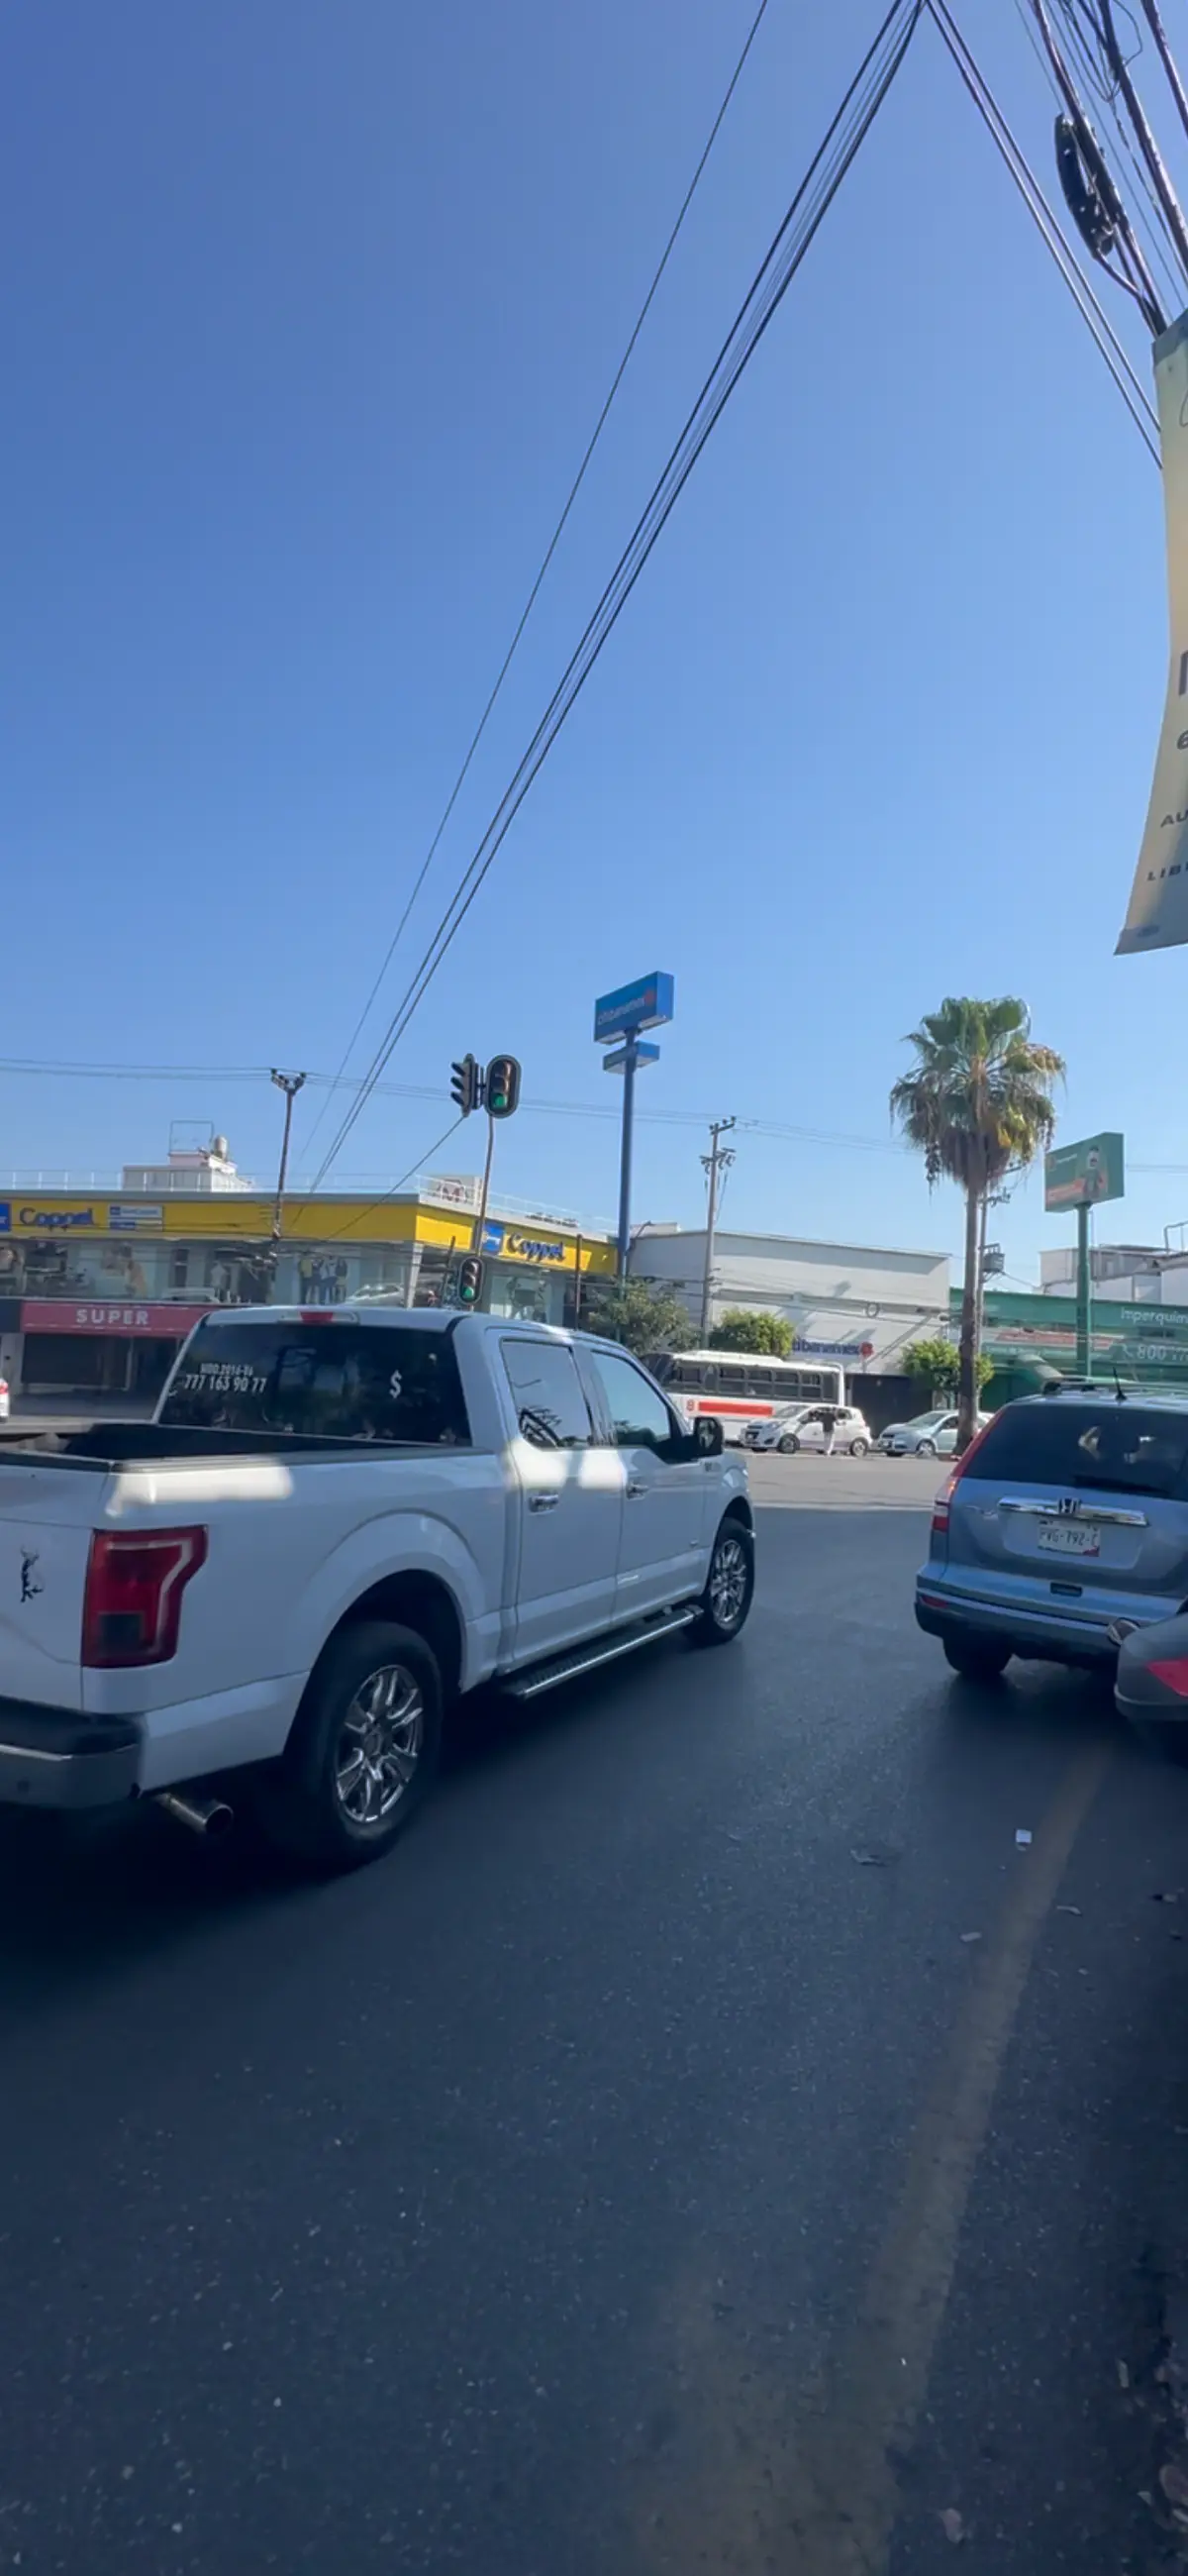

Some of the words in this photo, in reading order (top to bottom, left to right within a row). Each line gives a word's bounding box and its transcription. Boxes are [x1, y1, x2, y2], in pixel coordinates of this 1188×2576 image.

[1146, 861, 1188, 881] LIB
[507, 1232, 564, 1261] Coppel
[76, 1308, 148, 1325] SUPER
[1137, 1344, 1166, 1360] 800
[184, 1374, 207, 1391] 777
[234, 1378, 248, 1392] 90
[251, 1378, 267, 1394] 77
[389, 1370, 402, 1398] $
